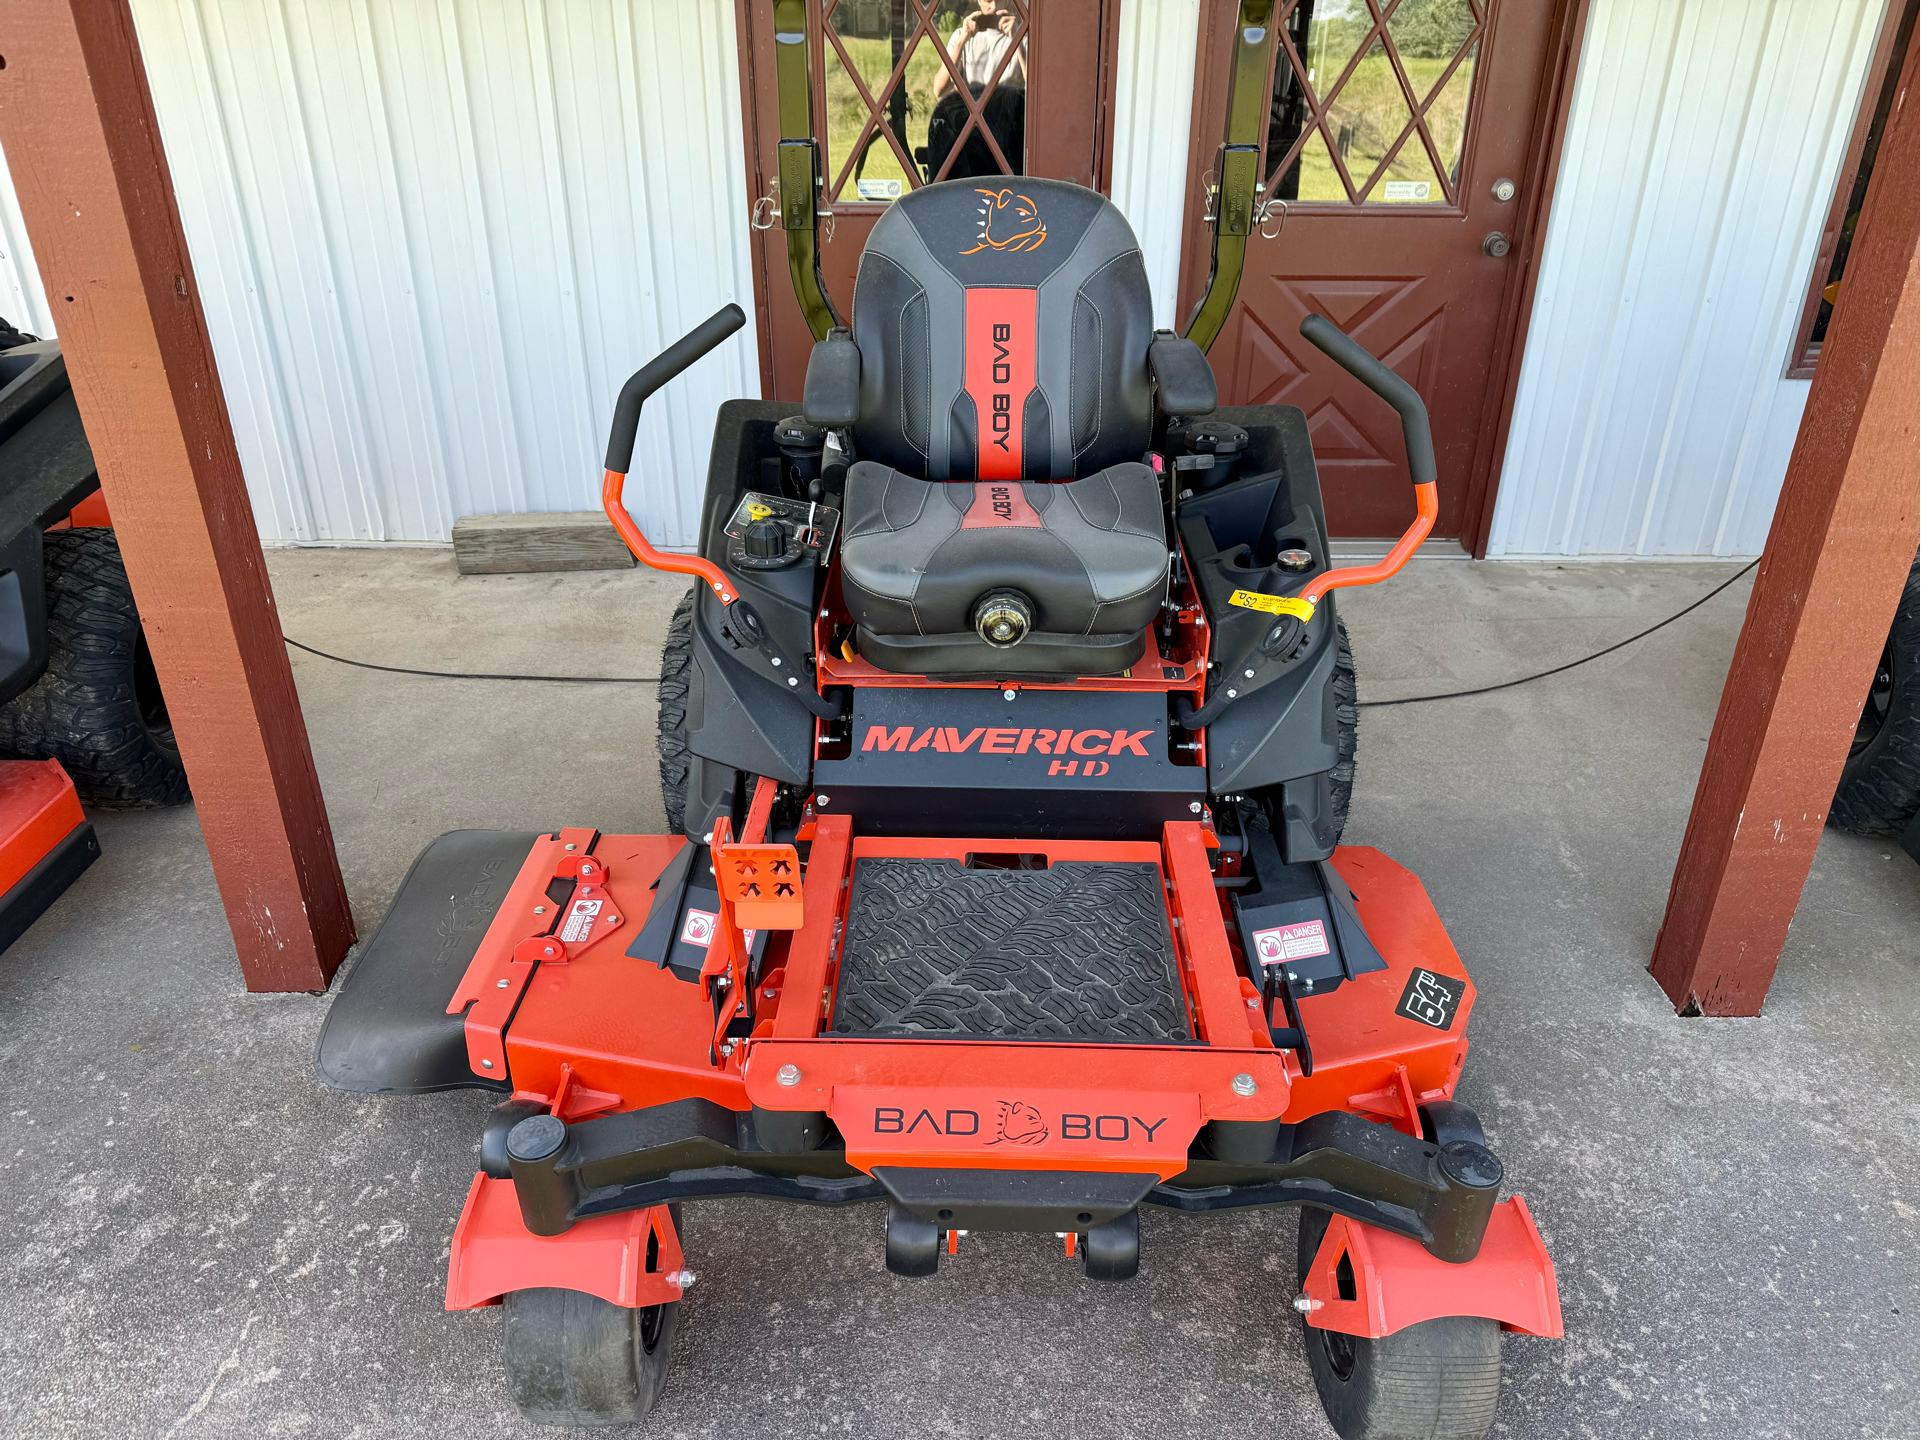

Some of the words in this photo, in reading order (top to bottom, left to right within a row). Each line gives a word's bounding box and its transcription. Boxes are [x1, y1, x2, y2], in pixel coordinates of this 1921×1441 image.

[993, 324, 1010, 383] BAD
[993, 394, 1010, 453] BOY
[993, 502, 1011, 521] BOY
[861, 726, 1156, 756] MAVERICK
[1047, 760, 1110, 777] HD
[1292, 924, 1322, 938] DANGER
[874, 1107, 979, 1136] BAD
[1061, 1113, 1168, 1142] BOY
